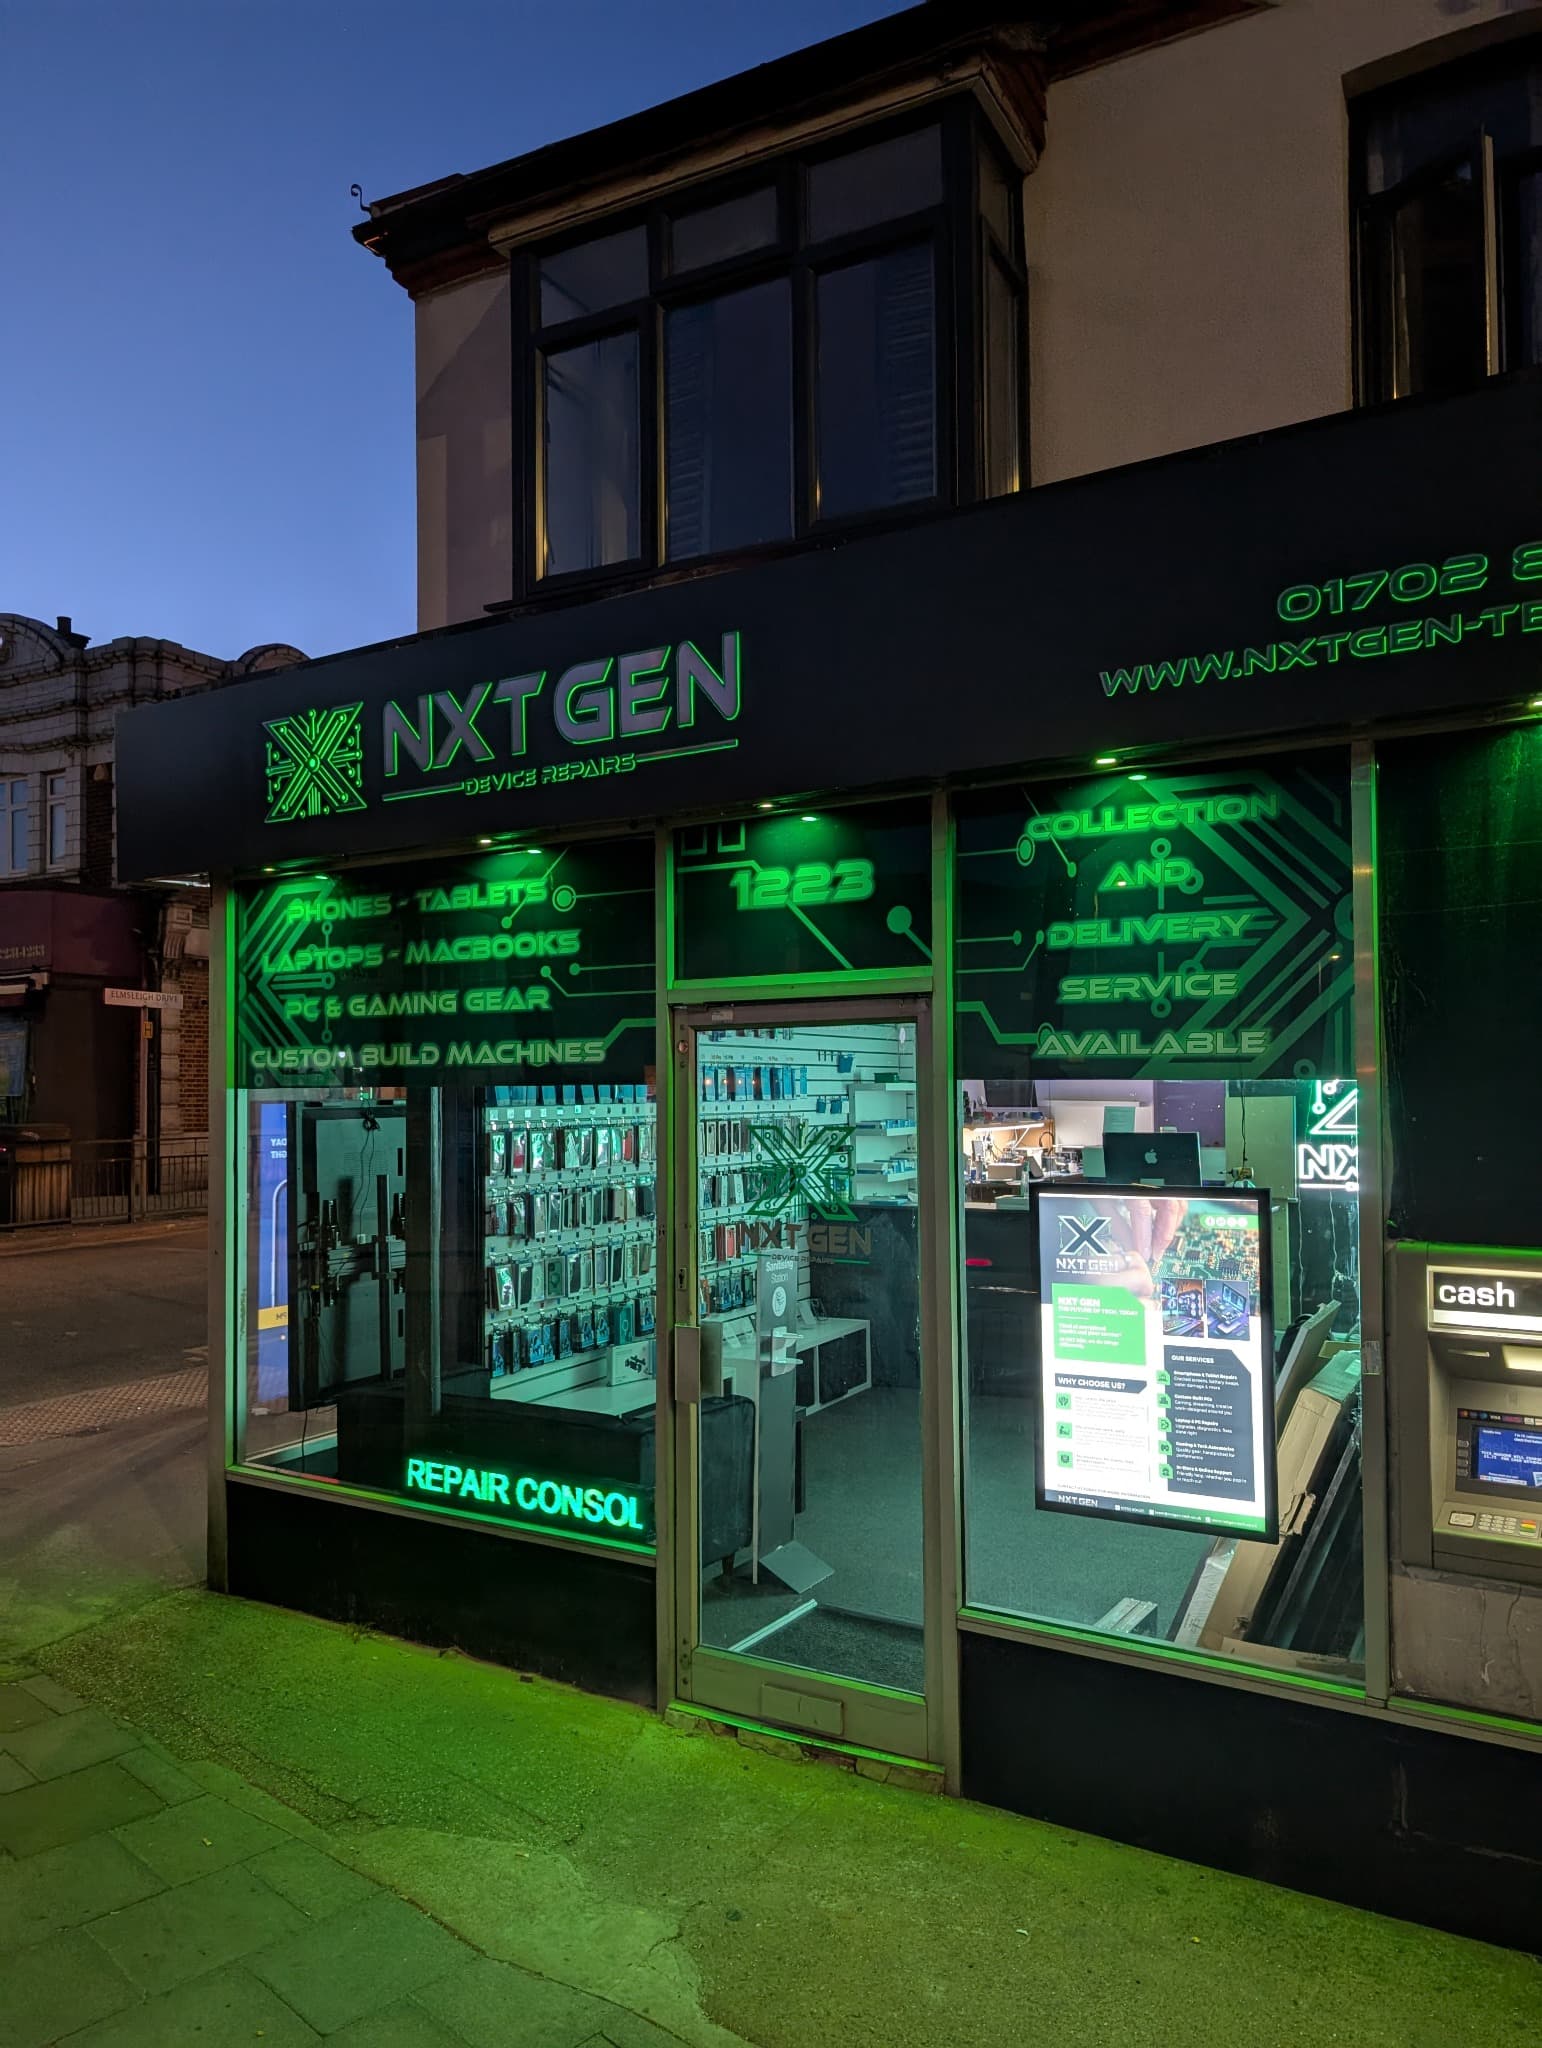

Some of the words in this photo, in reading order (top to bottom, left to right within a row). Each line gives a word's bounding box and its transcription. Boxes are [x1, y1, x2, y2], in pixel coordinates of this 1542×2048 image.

[1277, 553, 1488, 621] 01702
[1099, 600, 1542, 697] WWW.NXTGEN-TE
[383, 671, 547, 777] NXT
[553, 631, 741, 745] GEN
[464, 767, 537, 796] DEVICE
[541, 753, 636, 784] REPAIRS
[1025, 795, 1278, 840] COLLECTION
[730, 859, 875, 910] 1223
[1104, 860, 1192, 889] AND
[287, 896, 391, 924] PHONES
[416, 879, 547, 911] TABLETS
[1047, 913, 1255, 949] DELIVERY
[262, 945, 384, 974] LAPTOPS
[405, 930, 580, 964] MACBOOKS
[111, 990, 154, 1001] ELMSLEIGH
[156, 994, 178, 1003] DRIVE
[285, 997, 322, 1021] PC
[325, 998, 341, 1019] &
[348, 988, 458, 1017] GAMING
[463, 987, 552, 1012] GEAR
[1059, 973, 1239, 1001] SERVICE
[251, 1046, 354, 1068] CUSTOM
[360, 1044, 439, 1067] BUILD
[447, 1041, 605, 1065] MACHINES
[1036, 1030, 1268, 1058] AVAILABLE
[740, 1221, 801, 1250] NXT
[807, 1225, 871, 1256] GEN
[1056, 1258, 1087, 1270] NXT
[1088, 1259, 1119, 1271] GEN
[1439, 1281, 1516, 1308] cash
[1185, 1355, 1214, 1364] SERVICES
[1057, 1377, 1077, 1385] WHY
[1078, 1379, 1110, 1388] CHOOSE
[1111, 1381, 1126, 1390] US?
[1058, 1494, 1078, 1506] NXT
[1079, 1496, 1098, 1508] GEN
